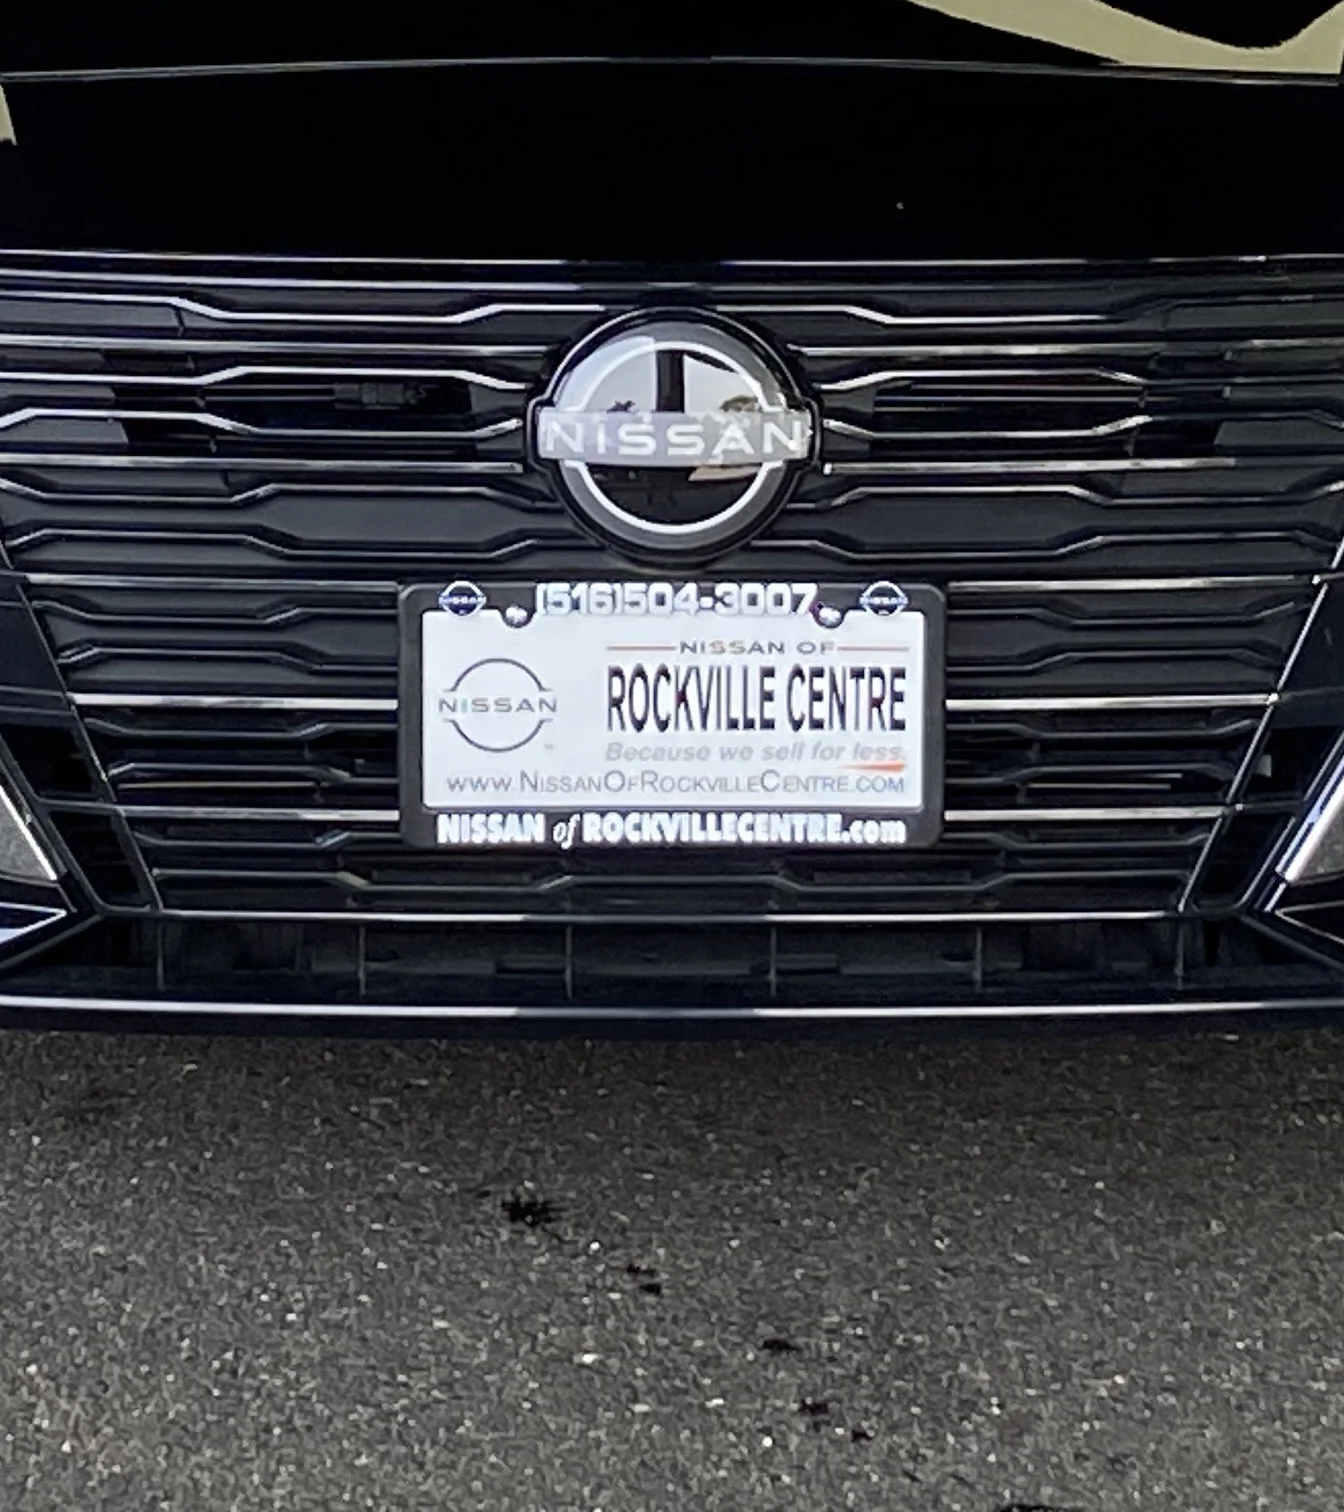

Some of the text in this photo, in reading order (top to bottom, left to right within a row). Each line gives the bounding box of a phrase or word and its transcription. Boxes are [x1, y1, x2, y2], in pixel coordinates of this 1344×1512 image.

[546, 420, 802, 456] NISSAN
[536, 582, 818, 616] (516)504-3007
[680, 640, 835, 655] NISSAN OF
[439, 696, 557, 713] NISSAN
[607, 663, 906, 732] ROCKVILLE CENTRE
[605, 742, 711, 762] Because
[720, 746, 754, 761] we
[761, 740, 805, 761] sell
[810, 740, 846, 761] for
[437, 811, 906, 850] NISSAN of ROCKVILLECENTRE.com
